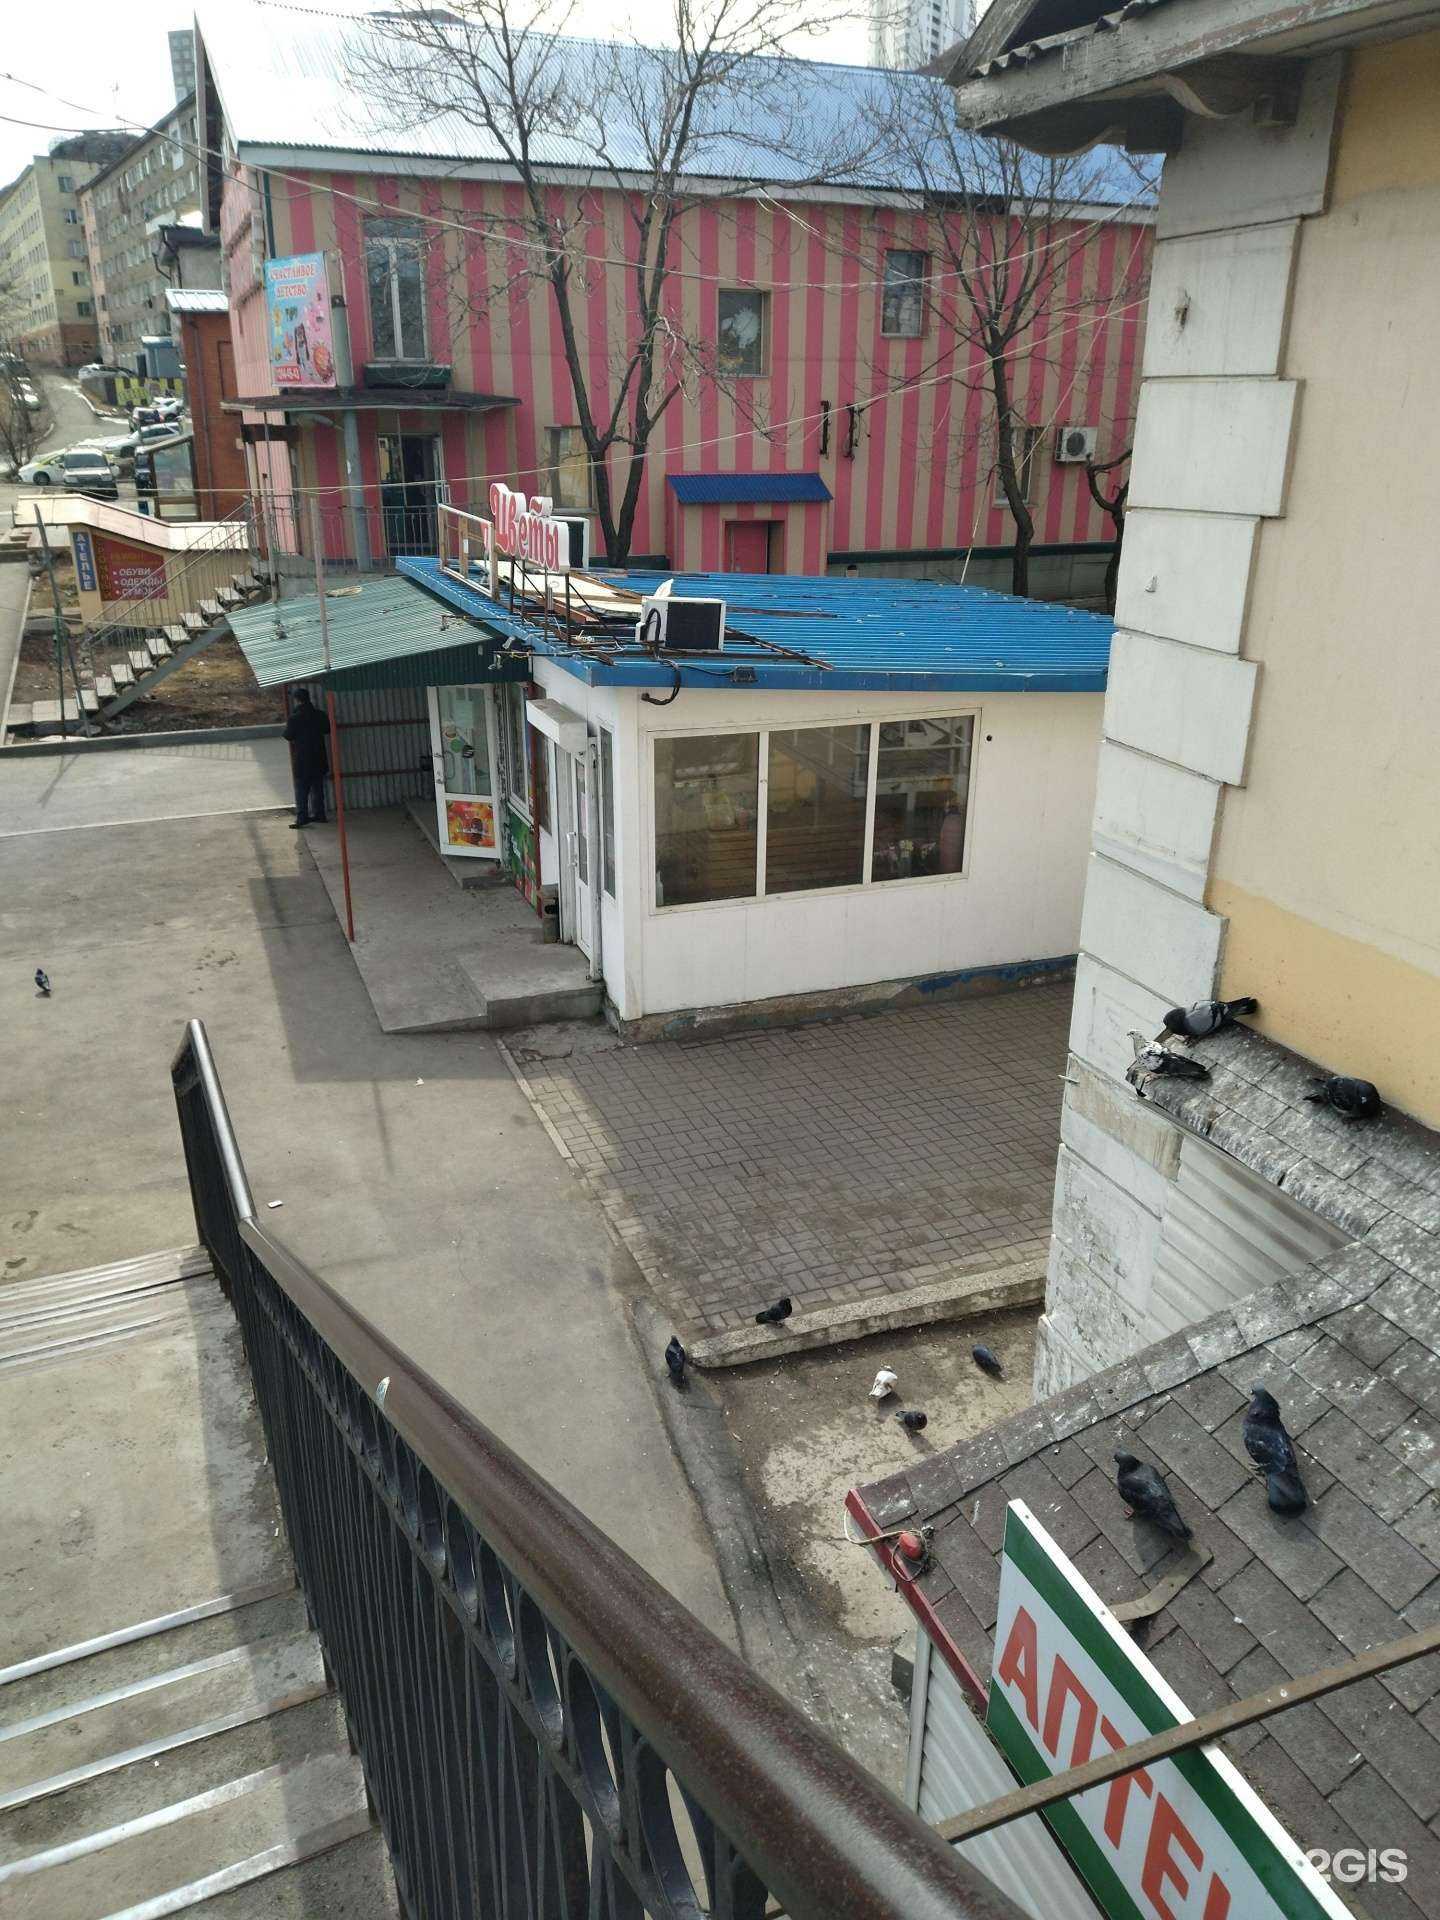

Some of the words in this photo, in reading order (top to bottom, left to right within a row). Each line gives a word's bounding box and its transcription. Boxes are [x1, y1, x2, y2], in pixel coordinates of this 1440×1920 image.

[76, 533, 93, 590] АТЕЛЬЕ
[119, 567, 151, 576] ОБУВИ
[998, 1605, 1231, 1920] АПТЕ
